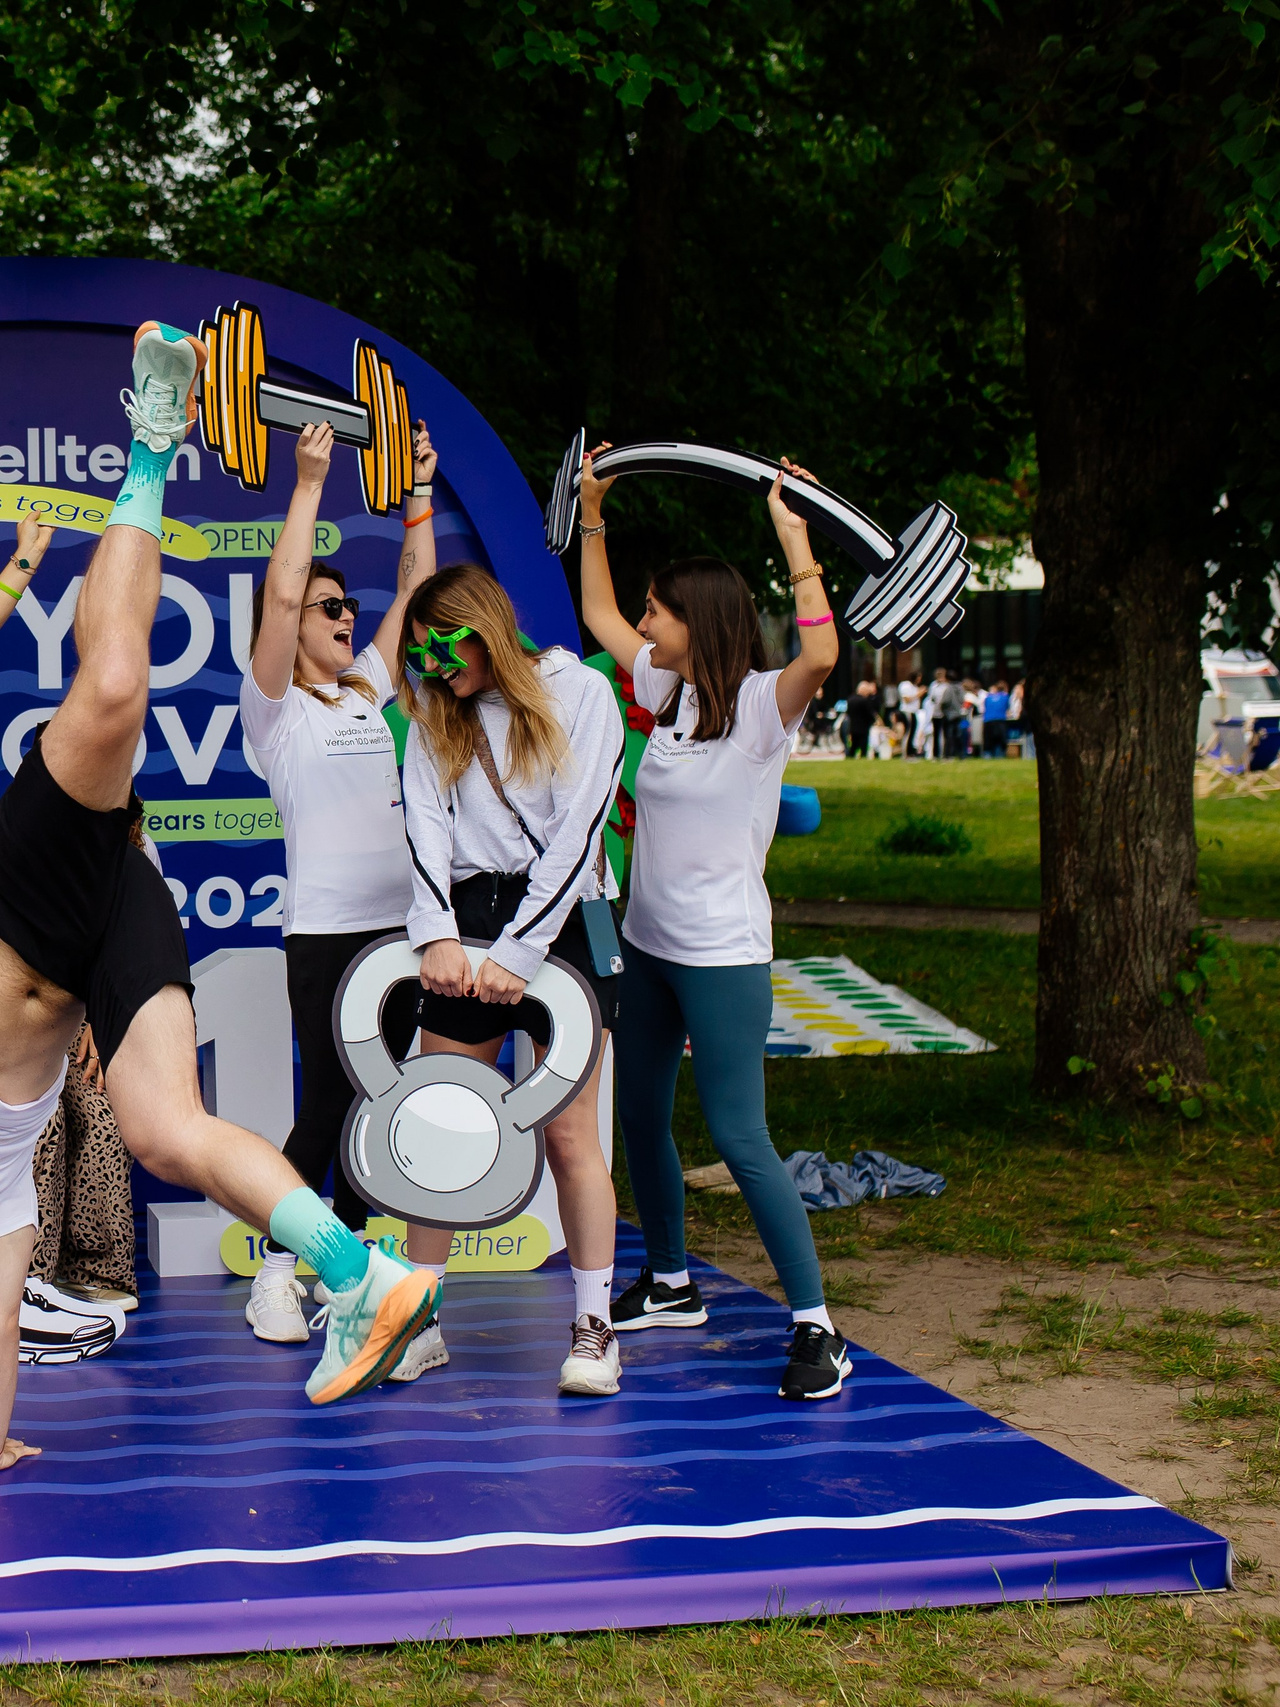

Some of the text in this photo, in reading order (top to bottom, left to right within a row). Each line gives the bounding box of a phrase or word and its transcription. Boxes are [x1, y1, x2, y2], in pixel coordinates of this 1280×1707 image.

[16, 495, 182, 544] toger
[201, 527, 276, 551] OPEN
[325, 738, 355, 747] Verson
[141, 814, 206, 831] ears
[391, 1230, 528, 1258] ether
